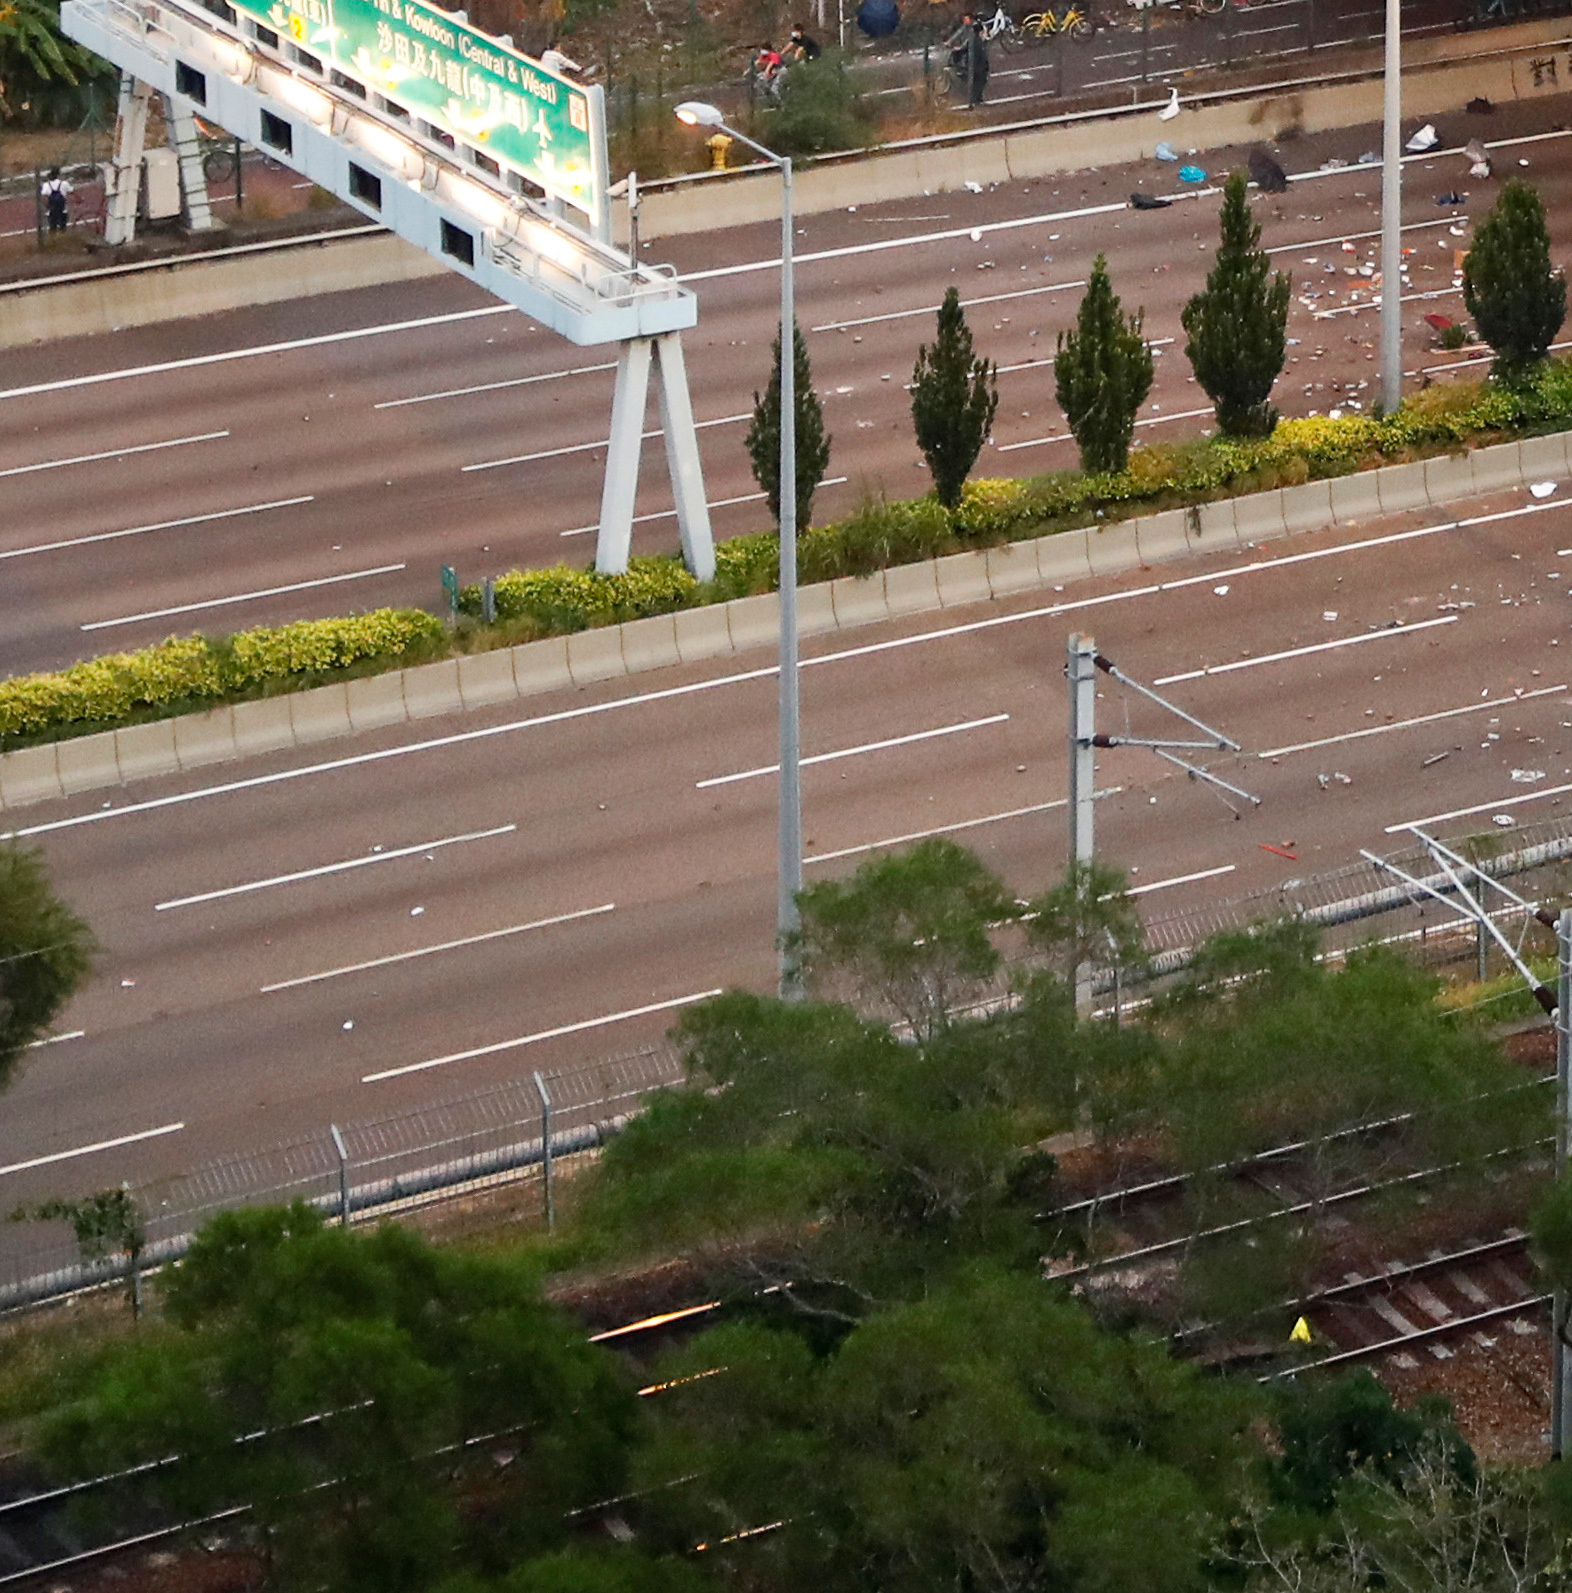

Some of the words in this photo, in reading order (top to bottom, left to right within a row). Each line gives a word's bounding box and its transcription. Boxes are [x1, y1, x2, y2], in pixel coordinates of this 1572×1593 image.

[404, 4, 456, 50] Kowloon
[457, 32, 506, 79] (Central
[507, 58, 519, 84] &
[520, 65, 558, 106] West)
